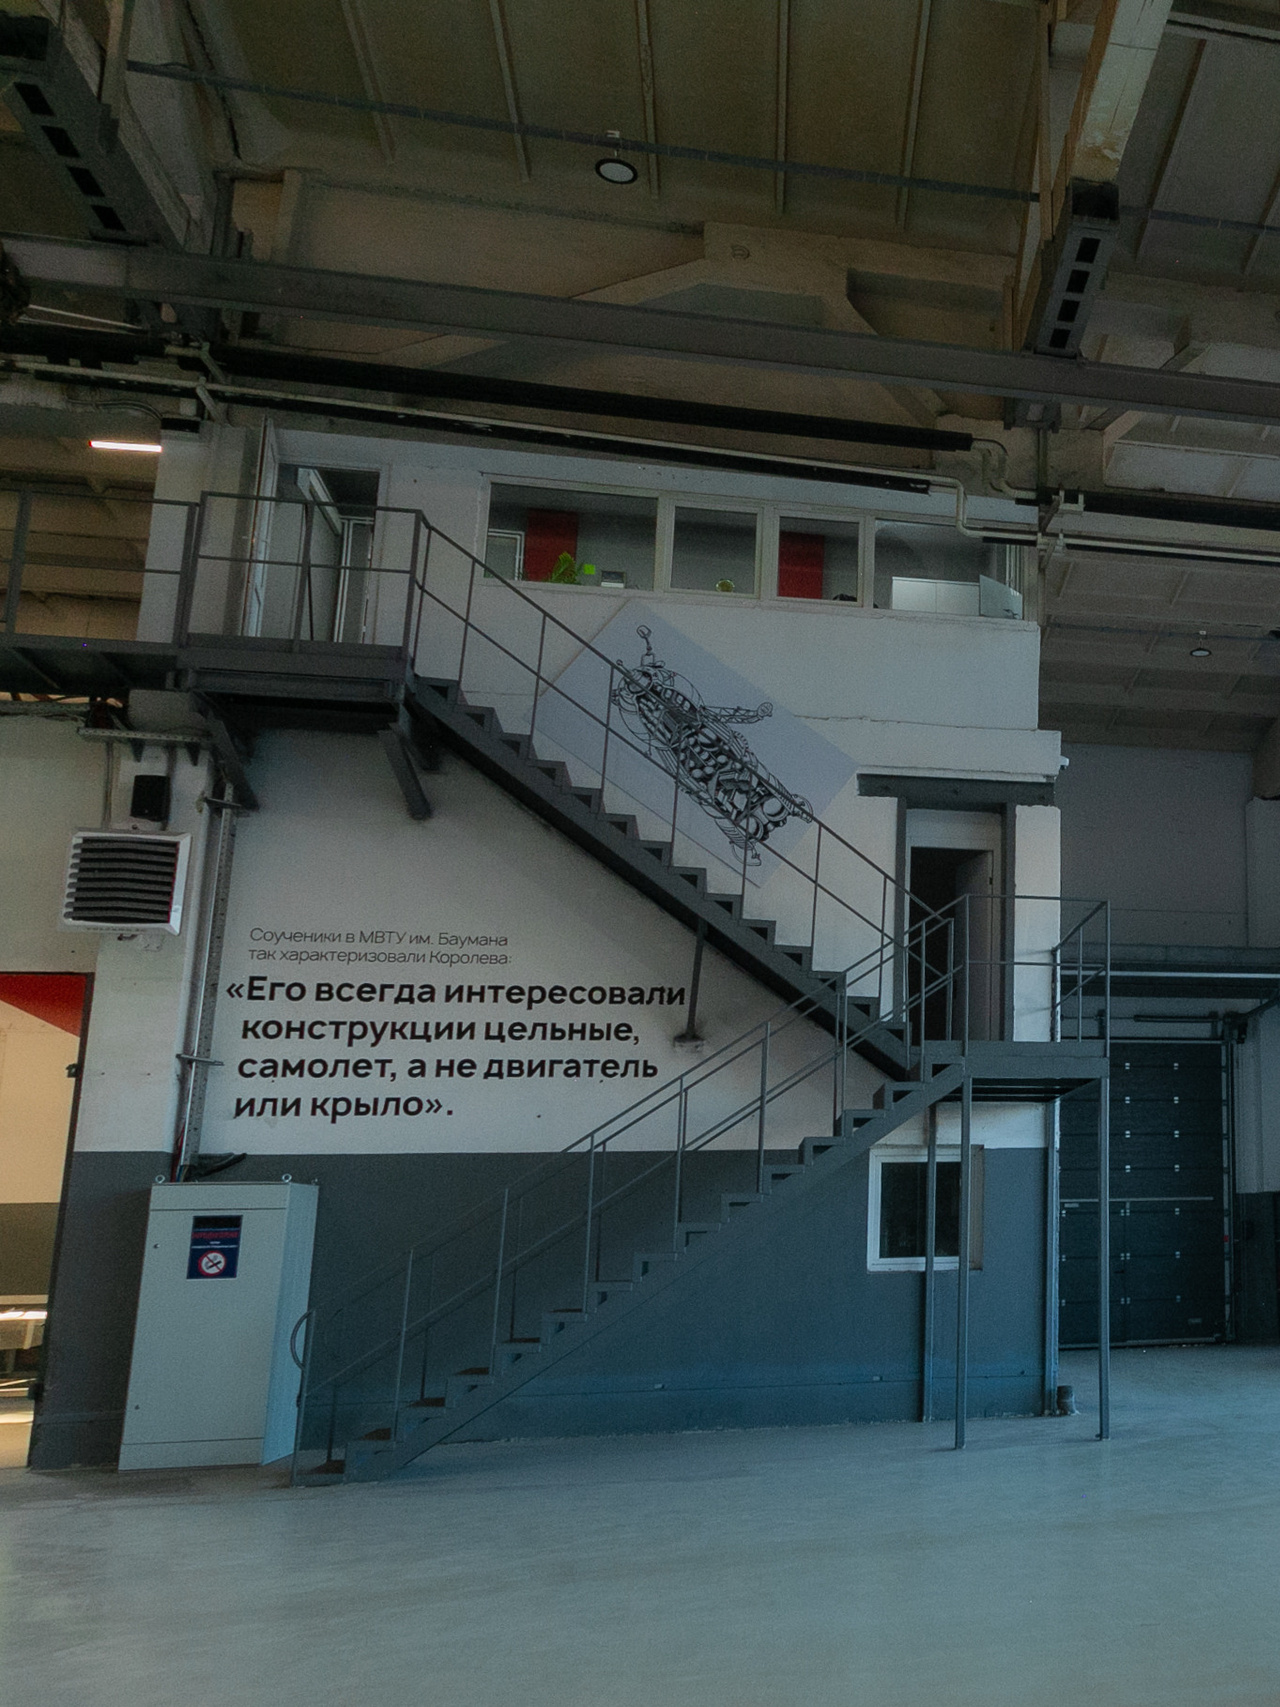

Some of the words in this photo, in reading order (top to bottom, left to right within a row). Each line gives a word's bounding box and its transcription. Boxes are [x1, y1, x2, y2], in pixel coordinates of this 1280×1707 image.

[249, 927, 342, 946] Соученики
[345, 932, 356, 944] в
[358, 930, 407, 945] МВТУ
[408, 934, 435, 946] им.
[438, 932, 509, 949] Баумана
[248, 949, 277, 962] так
[279, 950, 426, 966] характеризовали
[429, 950, 513, 968] Королева:
[226, 976, 307, 1002] «Его
[314, 981, 437, 1006] всегда
[443, 984, 686, 1011] интересовали
[242, 1019, 477, 1049] конструкции
[484, 1021, 640, 1046] цельные,
[237, 1057, 398, 1083] самолет,
[407, 1058, 427, 1079] а
[434, 1058, 478, 1079] не
[482, 1058, 659, 1081] двигатель
[232, 1096, 302, 1119] или
[309, 1096, 454, 1125] крыло».
